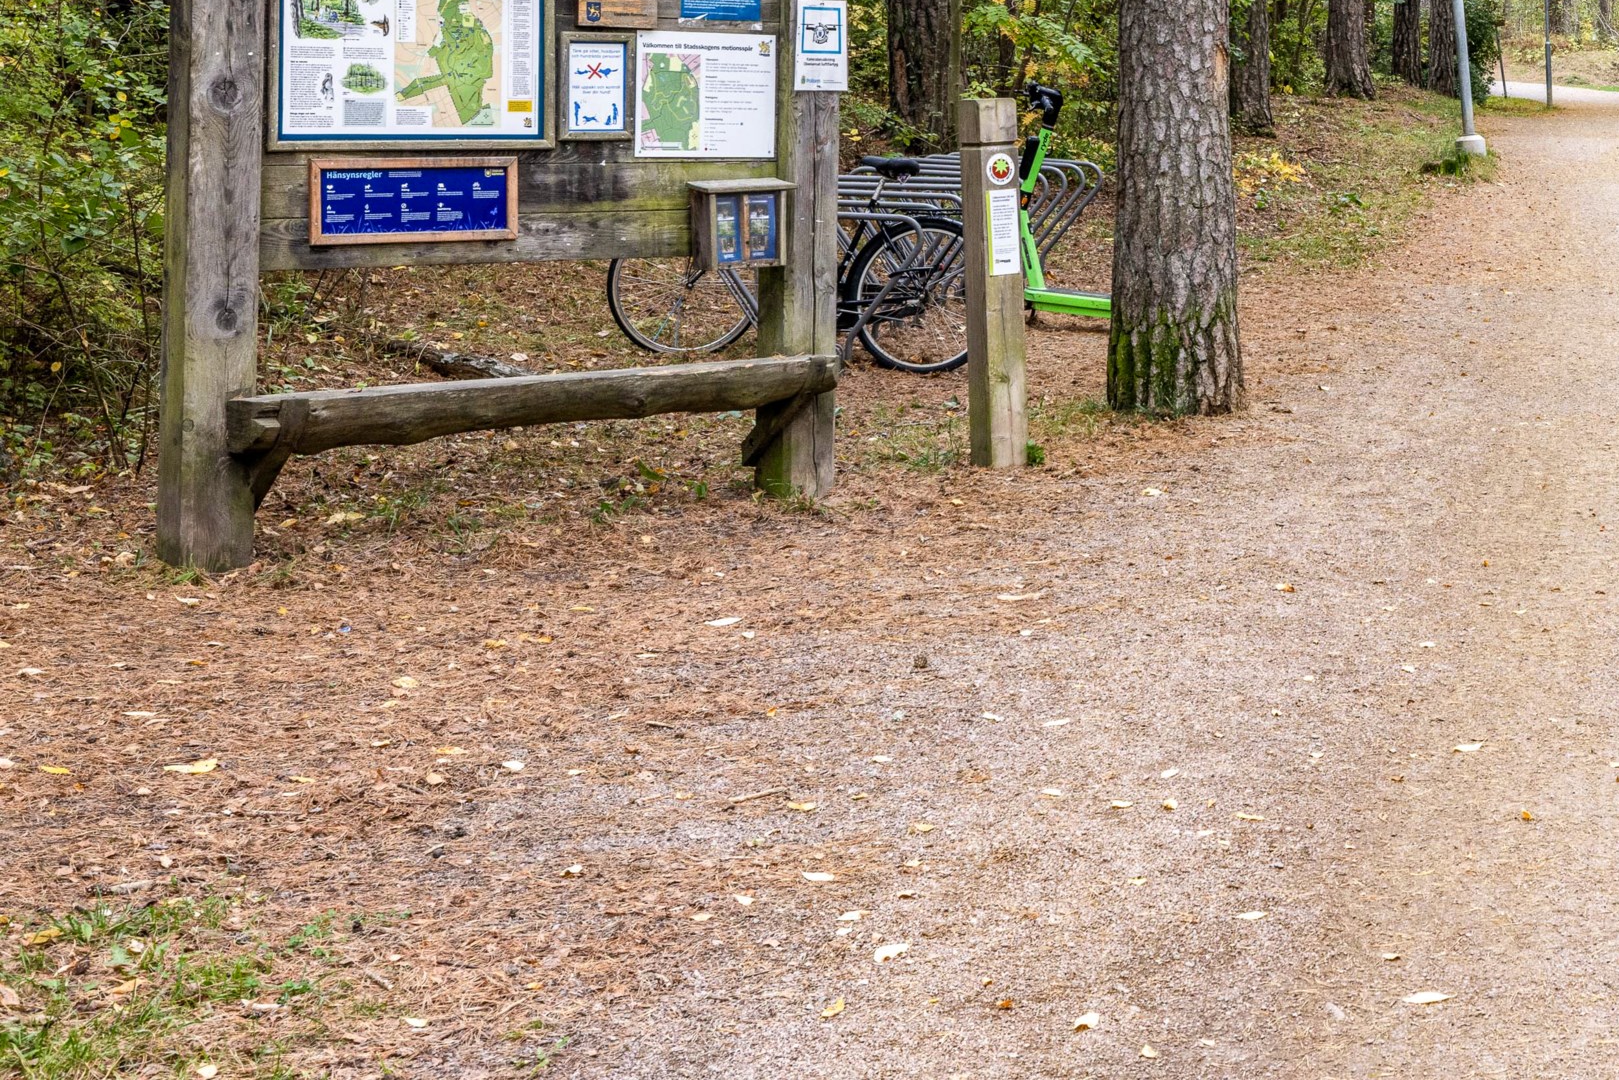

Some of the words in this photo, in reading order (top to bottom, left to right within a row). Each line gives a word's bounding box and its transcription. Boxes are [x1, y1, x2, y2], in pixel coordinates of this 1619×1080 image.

[683, 43, 720, 52] Stadsskogens
[721, 44, 754, 52] motionsspår
[326, 171, 382, 180] Hänsynsregler
